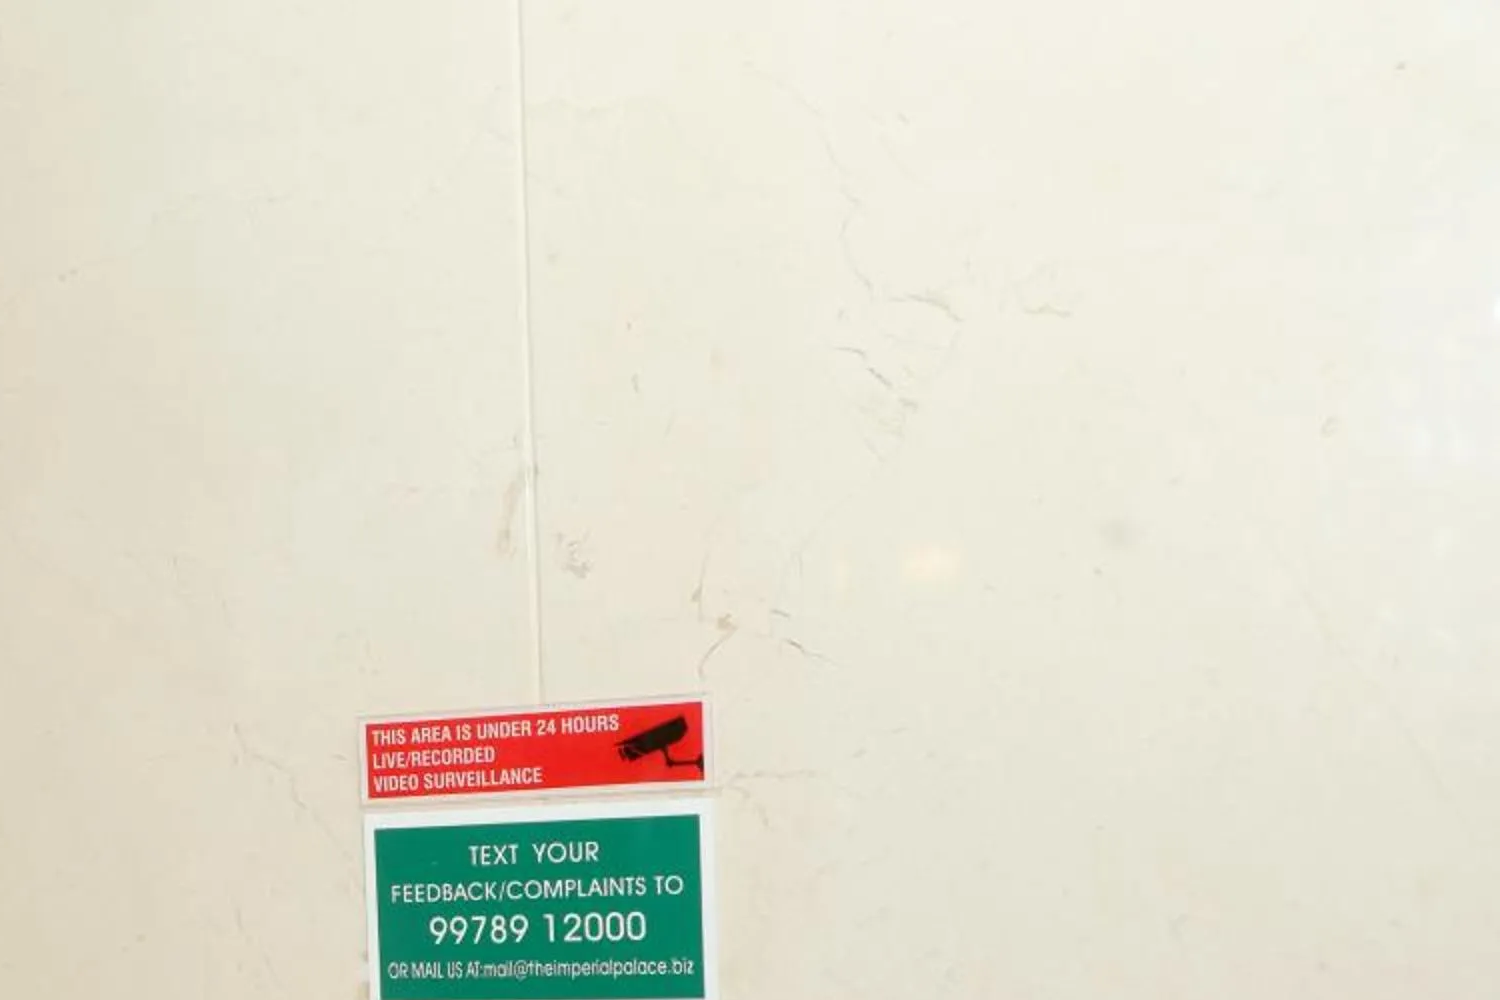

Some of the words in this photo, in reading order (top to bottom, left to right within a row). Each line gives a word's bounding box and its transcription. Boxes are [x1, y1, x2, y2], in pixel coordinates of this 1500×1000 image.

[372, 729, 406, 746] THIS
[411, 726, 451, 743] AREA
[456, 724, 472, 741] IS
[477, 720, 531, 740] UNDER
[536, 719, 557, 736] 24
[561, 714, 619, 734] HOURS
[372, 746, 495, 769] LIVE/RECORDED
[374, 774, 419, 793] VIDEO
[423, 767, 543, 790] SURVEILLANCE
[469, 844, 518, 866] TEXT
[532, 842, 599, 864] YOUR
[390, 876, 646, 903] FEEDBACK/COMPLAINTS
[654, 875, 683, 895] TO
[429, 914, 529, 944] 99789
[543, 911, 646, 942] 12000
[387, 961, 409, 979] OR
[411, 961, 444, 979] MAIL
[447, 960, 463, 979] US
